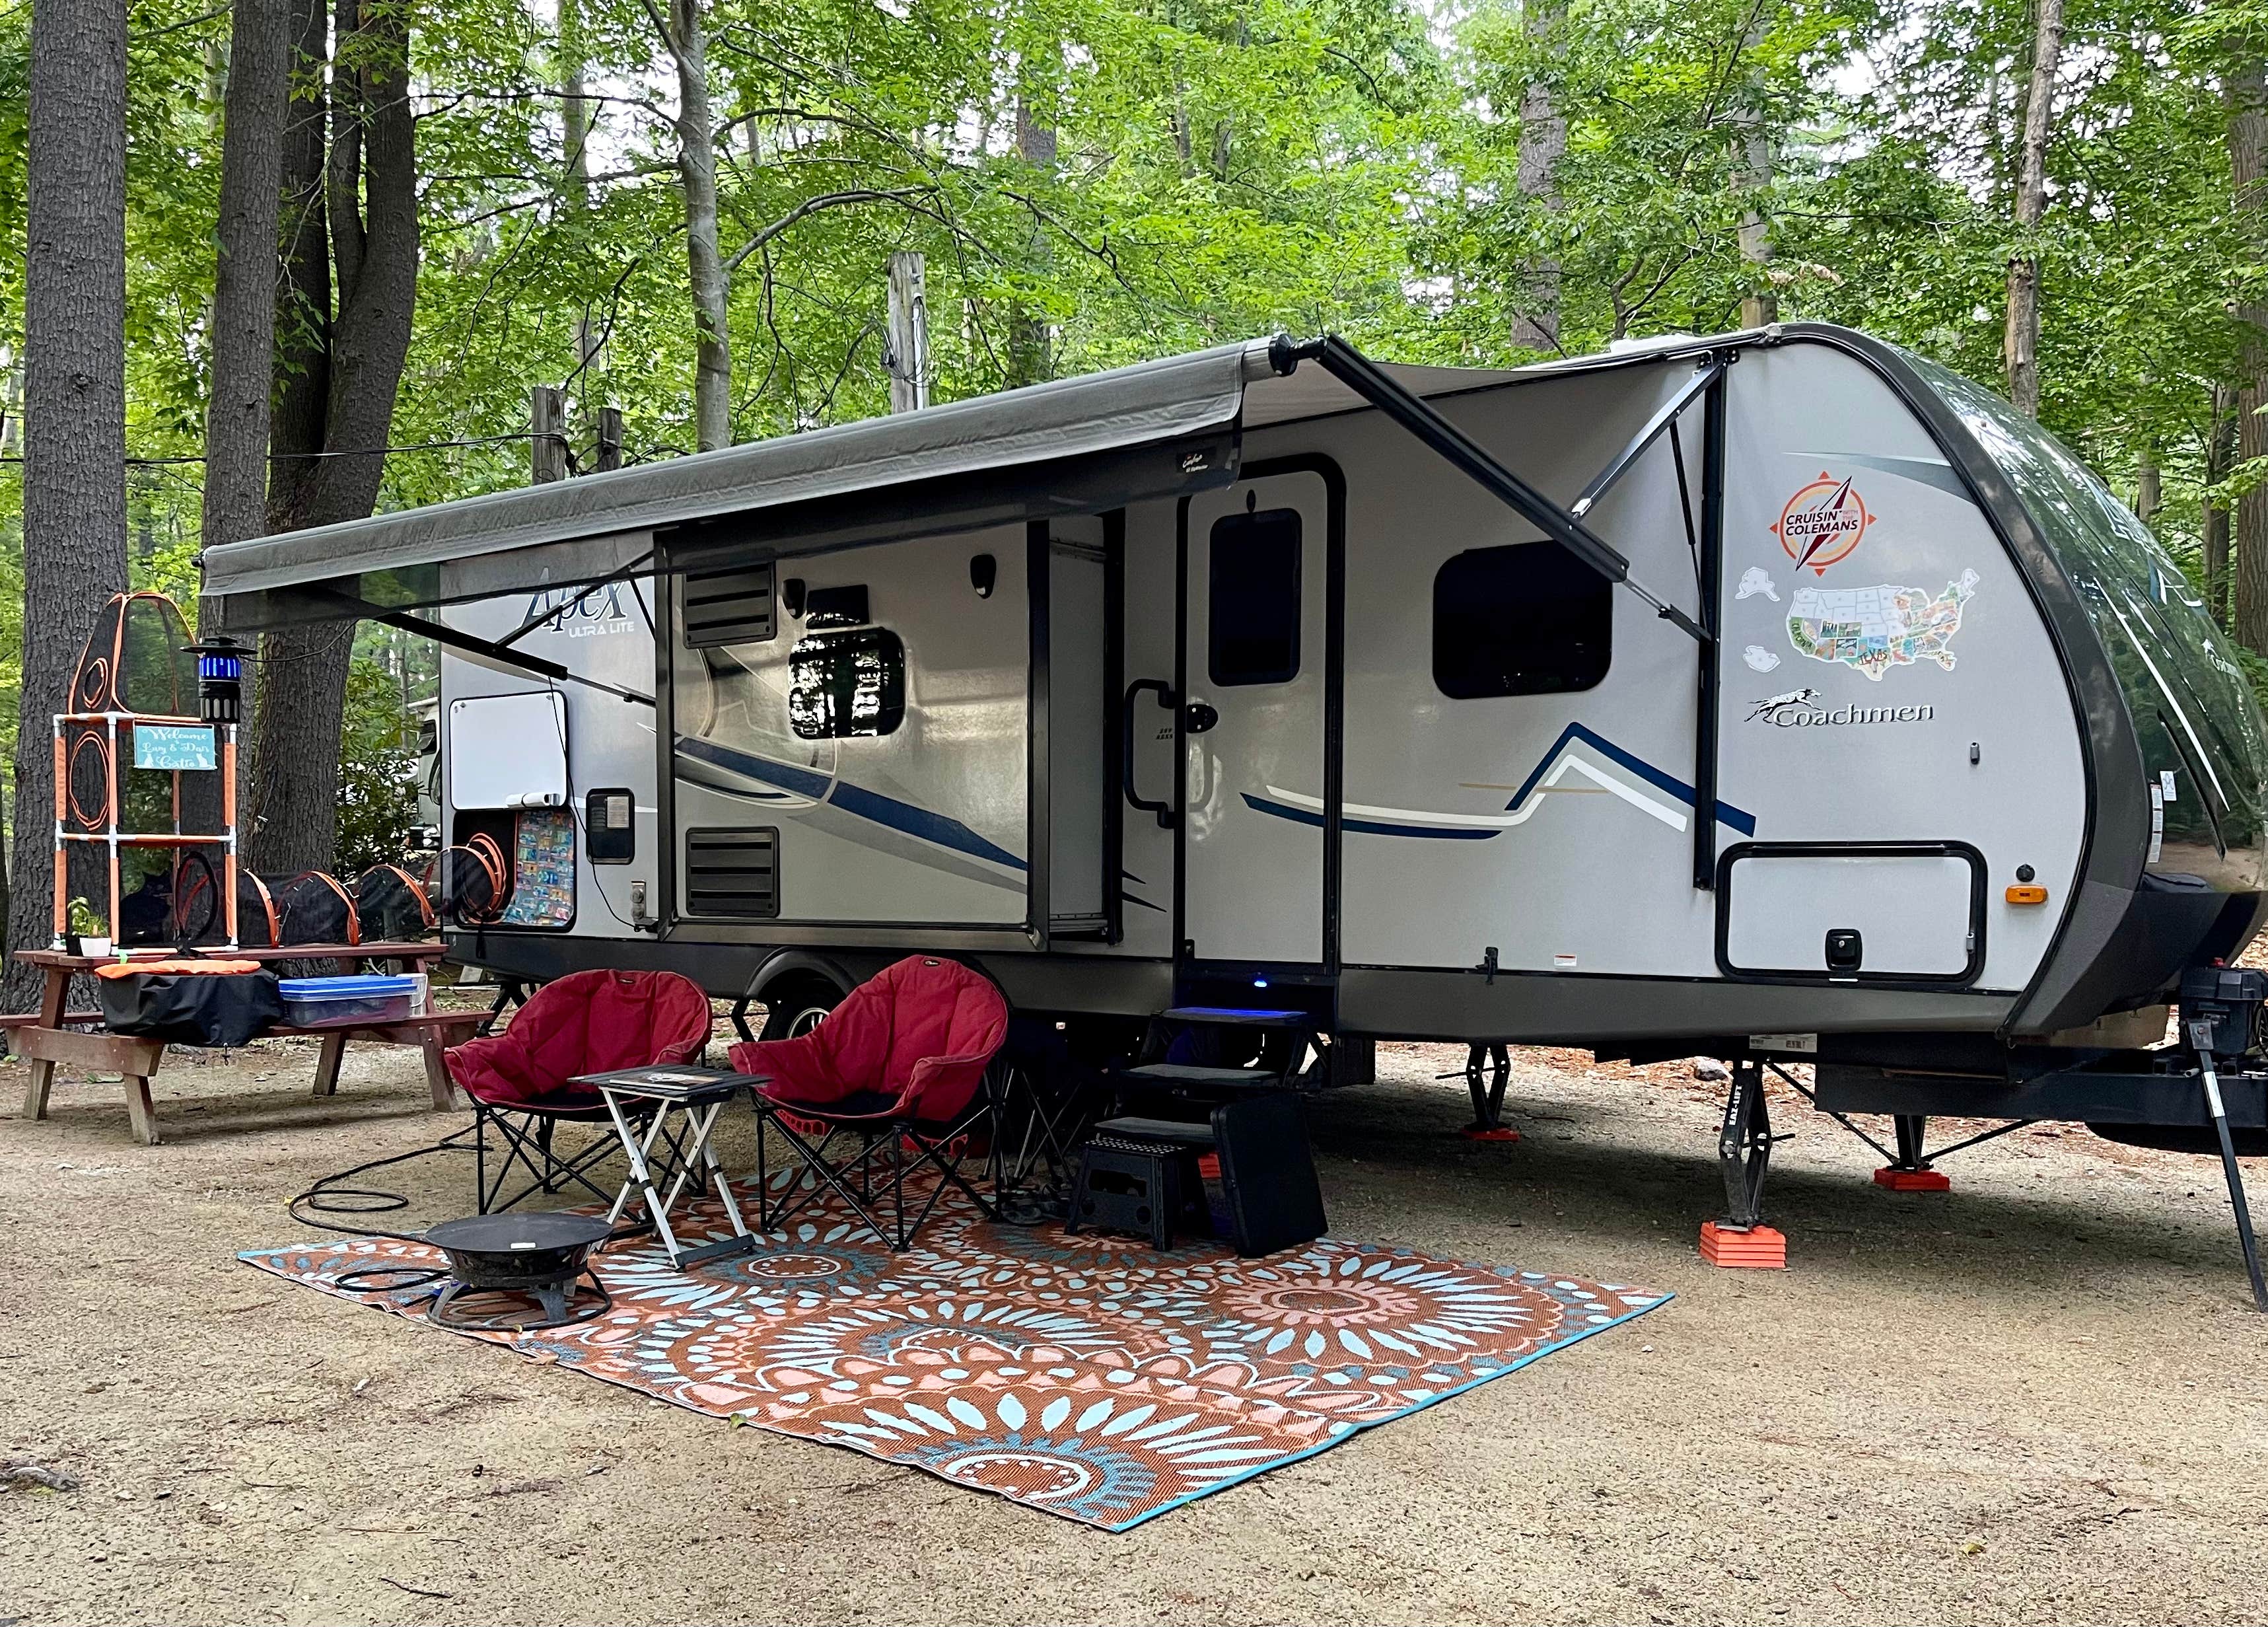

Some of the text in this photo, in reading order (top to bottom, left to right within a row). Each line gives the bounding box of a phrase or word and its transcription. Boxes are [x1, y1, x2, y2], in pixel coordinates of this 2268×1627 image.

[1786, 511, 1843, 525] CRUISIN'
[1786, 519, 1858, 536] COLEMANS
[569, 622, 635, 638] ULTRA LITE
[1858, 647, 1888, 665] TEXAS
[1773, 703, 1934, 728] Coachmen
[142, 727, 207, 741] Welcome
[169, 743, 178, 752] &
[1728, 1084, 1742, 1126] EAZ-LIFT
